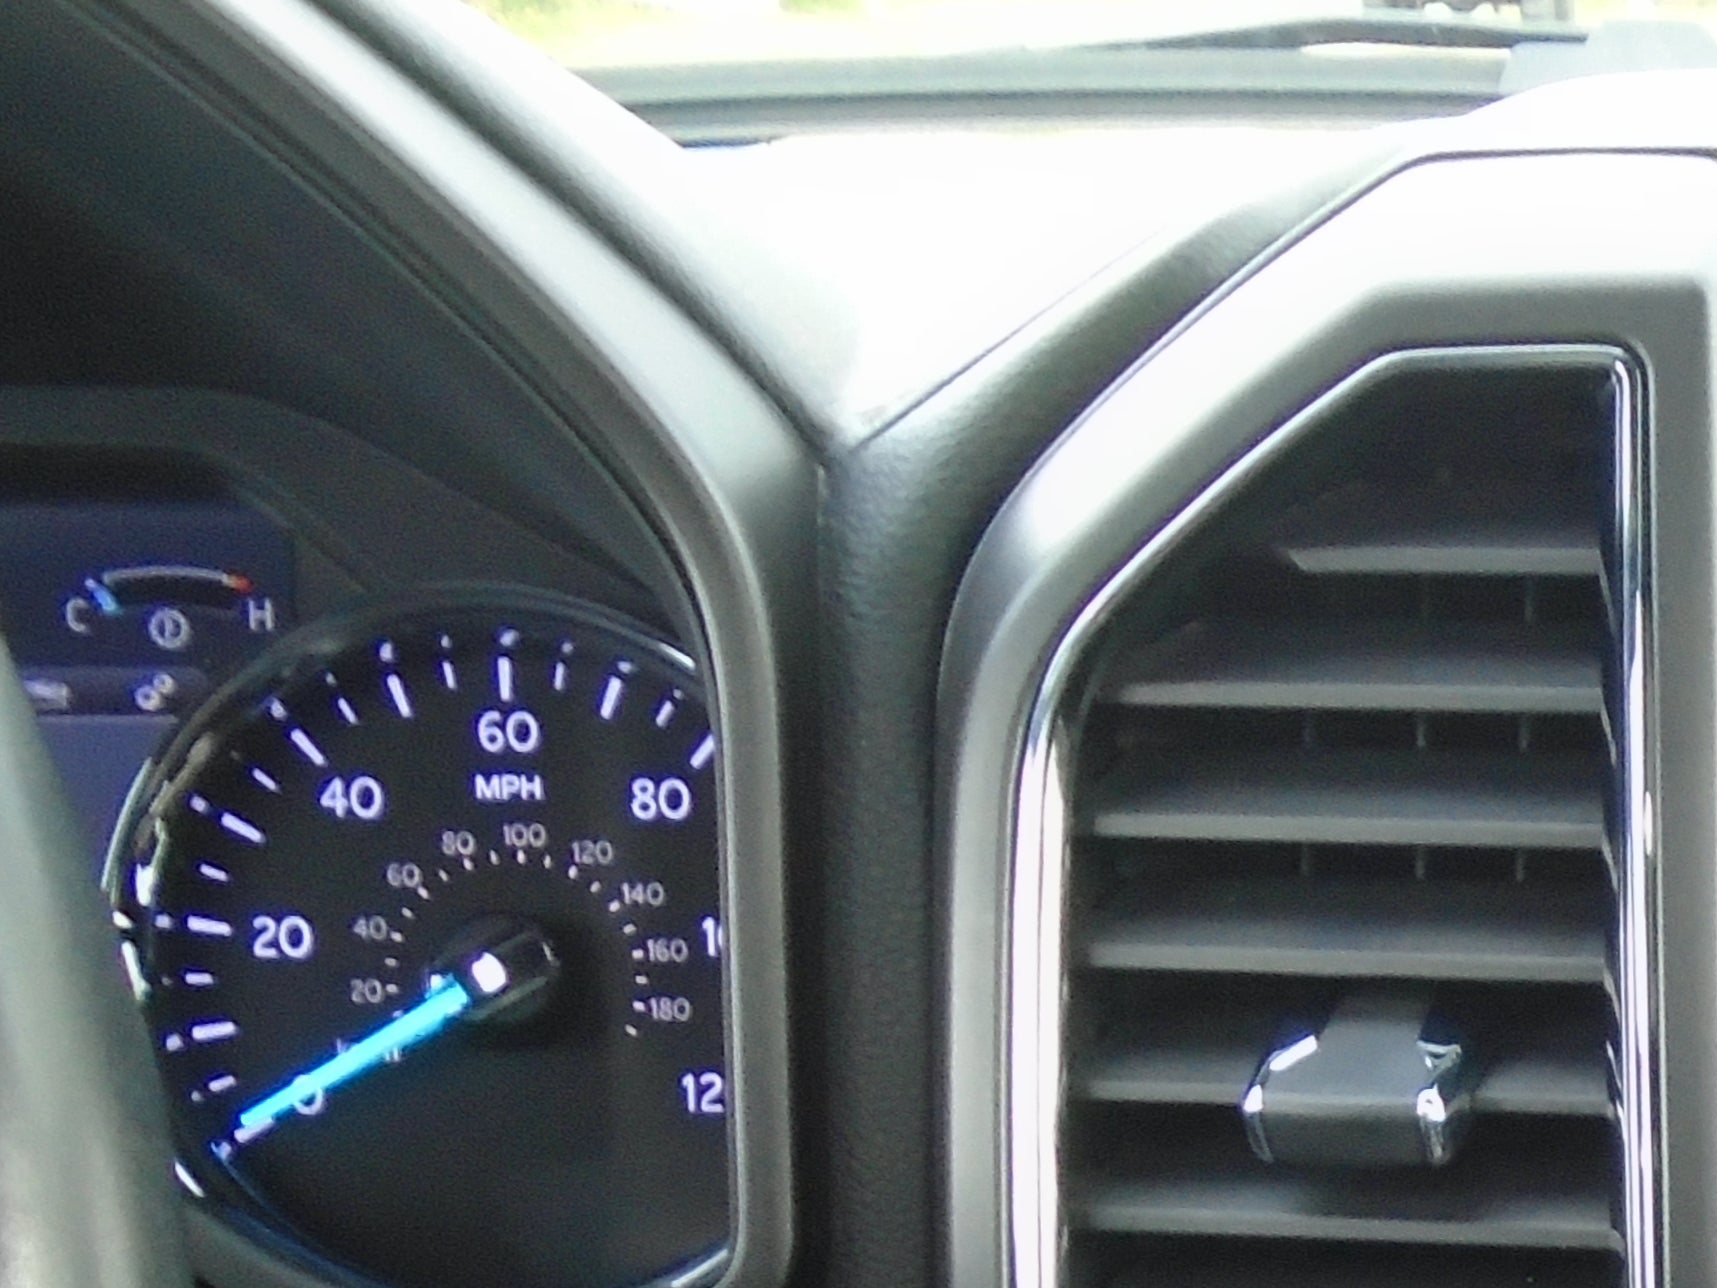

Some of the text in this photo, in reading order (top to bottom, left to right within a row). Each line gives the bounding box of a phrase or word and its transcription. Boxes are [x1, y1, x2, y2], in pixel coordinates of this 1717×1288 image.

[248, 598, 275, 632] H
[477, 710, 540, 753] 60
[319, 776, 384, 820] 40
[474, 773, 544, 801] MPH
[630, 777, 691, 821] 80
[441, 830, 476, 859] 80
[502, 822, 547, 851] 100
[569, 839, 615, 869] 120
[386, 863, 421, 891] 60
[617, 882, 665, 909] 140
[252, 915, 314, 959] 20
[352, 915, 389, 941] 40
[646, 938, 689, 963] 160
[350, 978, 385, 1004] 20
[649, 997, 691, 1022] 180
[681, 1071, 724, 1114] 12
